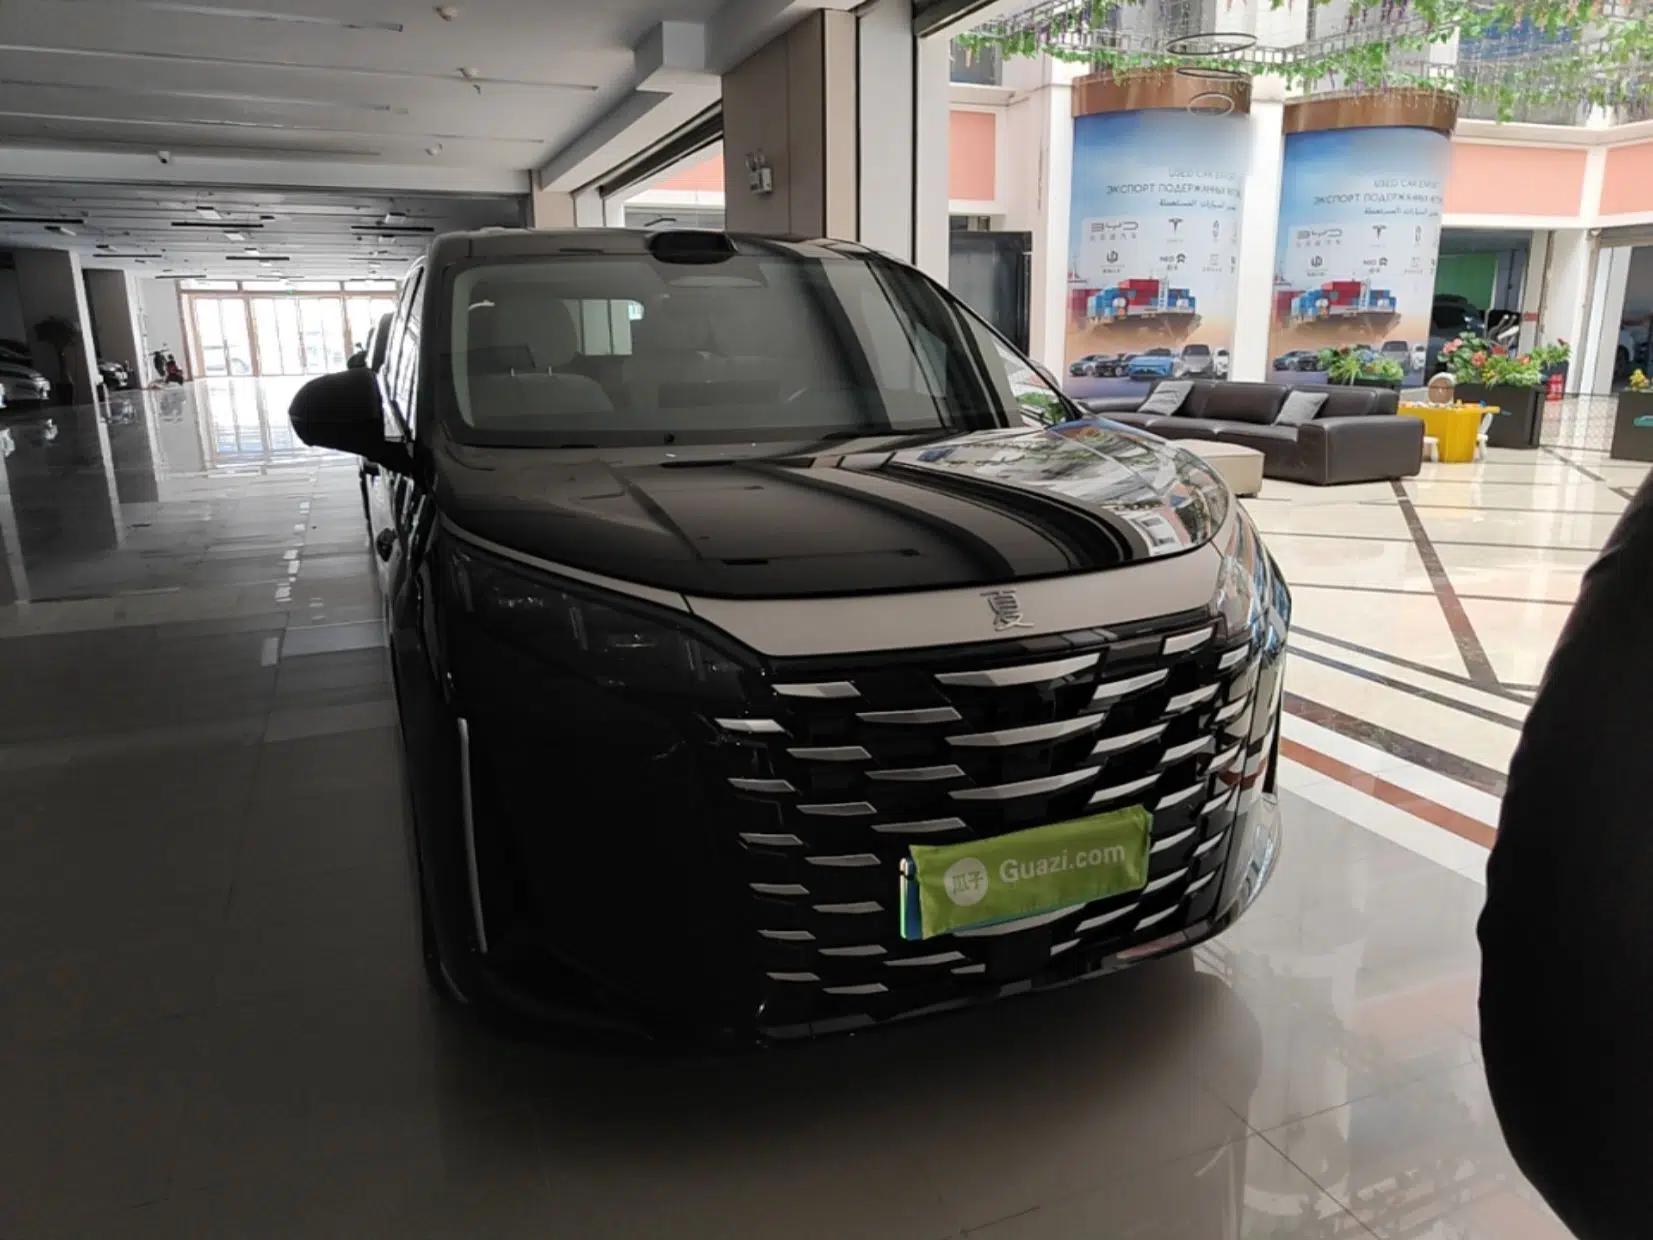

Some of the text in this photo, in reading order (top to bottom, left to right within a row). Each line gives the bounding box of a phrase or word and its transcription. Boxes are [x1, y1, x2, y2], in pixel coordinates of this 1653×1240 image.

[1105, 183, 1155, 195] ЭКСПОРТ
[1091, 221, 1139, 232] BYD
[1297, 229, 1343, 240] BYD
[1000, 844, 1126, 884] Guazi.com
